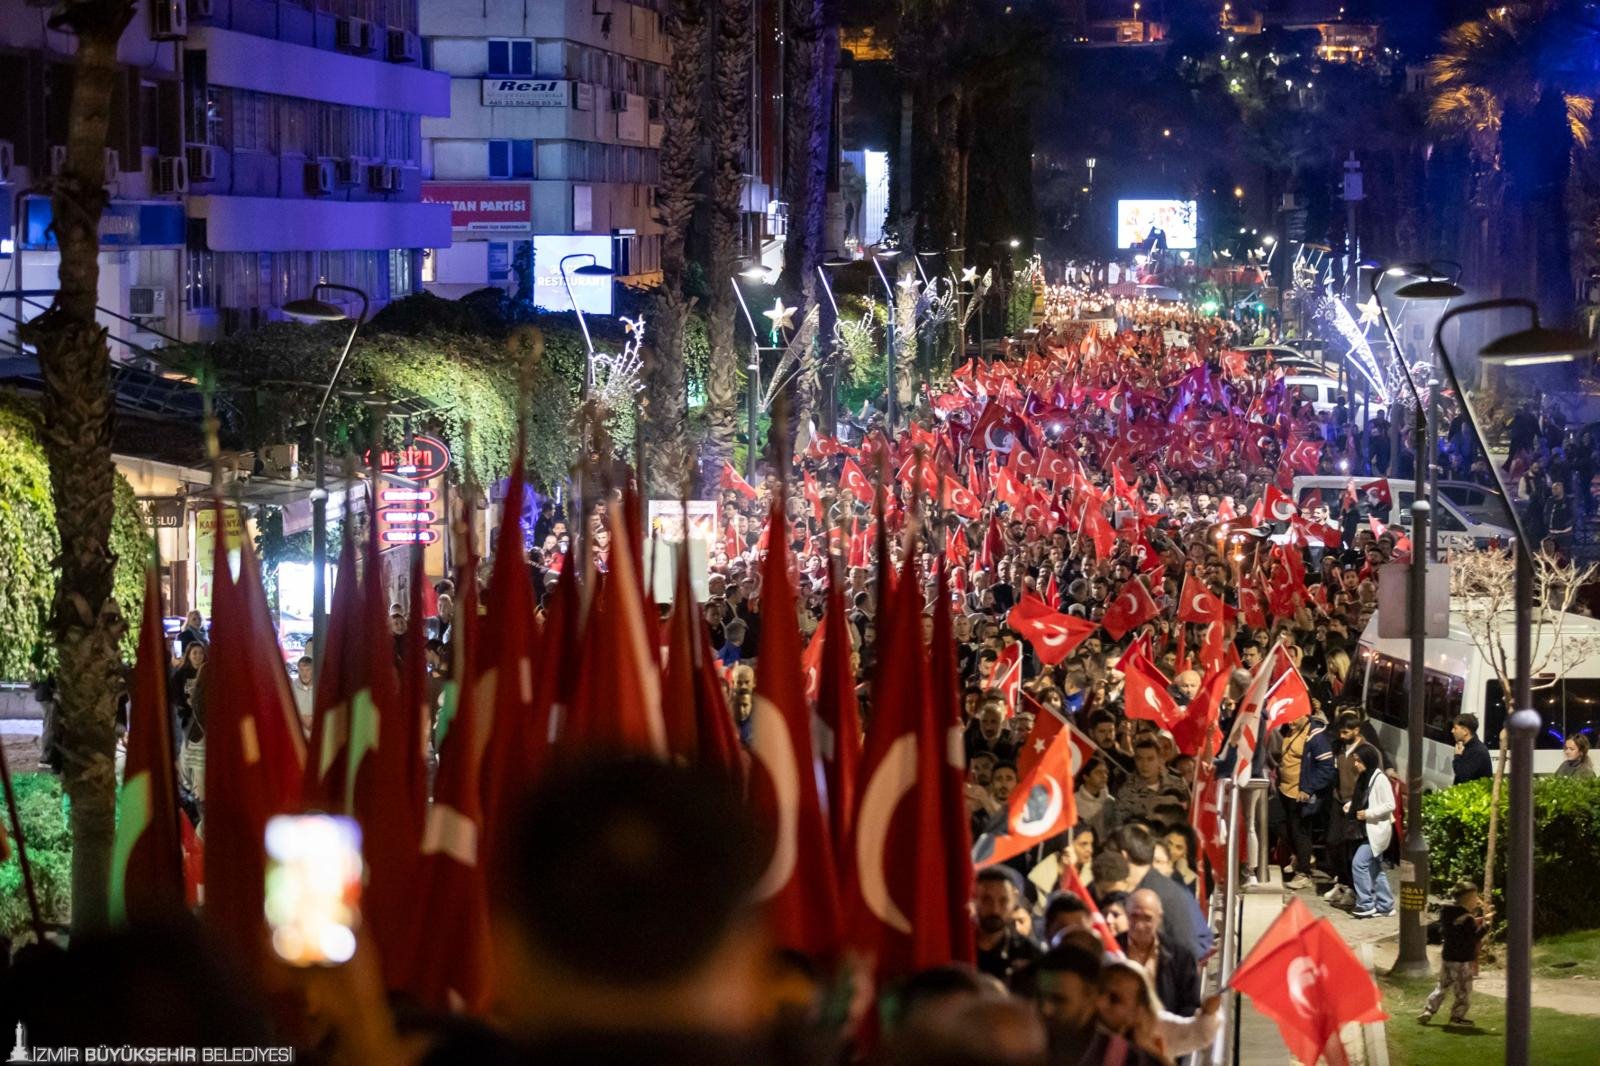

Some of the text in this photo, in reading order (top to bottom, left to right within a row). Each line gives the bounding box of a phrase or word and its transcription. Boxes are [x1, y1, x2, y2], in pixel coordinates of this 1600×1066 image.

[498, 81, 558, 92] Real
[436, 200, 526, 212] TAN PARTİSİ
[537, 276, 607, 287] RESTURANT
